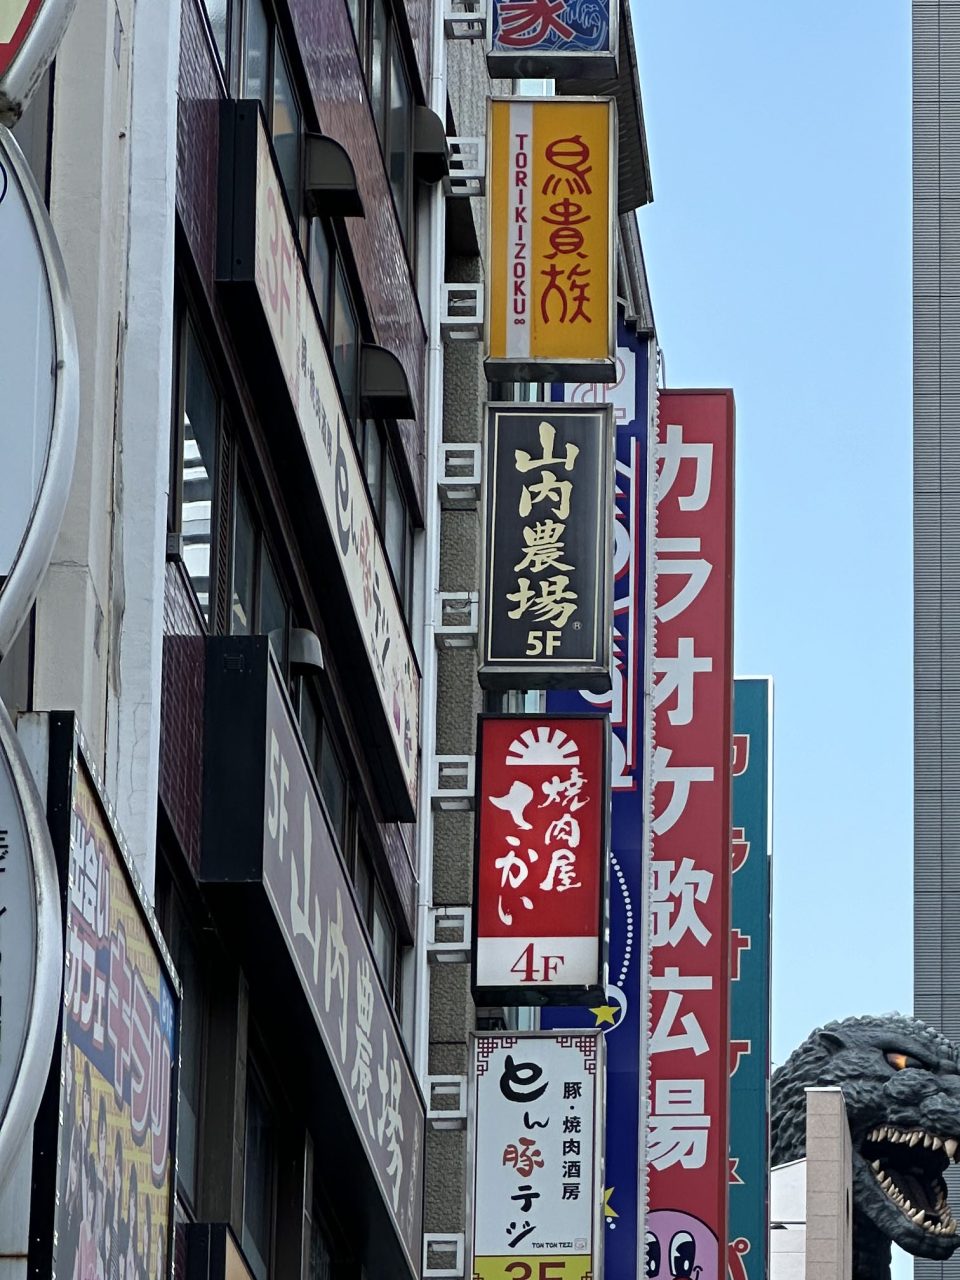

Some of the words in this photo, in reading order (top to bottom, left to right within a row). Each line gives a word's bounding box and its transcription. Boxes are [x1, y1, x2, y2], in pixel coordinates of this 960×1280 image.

[513, 133, 528, 315] TORIKIZOKU
[506, 421, 578, 628] 山内農場
[527, 632, 561, 656] 5F
[489, 780, 538, 926] さかい
[538, 766, 590, 892] 焼肉屋
[290, 791, 407, 1206] 山内農場
[510, 942, 565, 983] 4F
[501, 1055, 550, 1249] とん豚テジ
[562, 1081, 582, 1200] 豚・焼肉酒房
